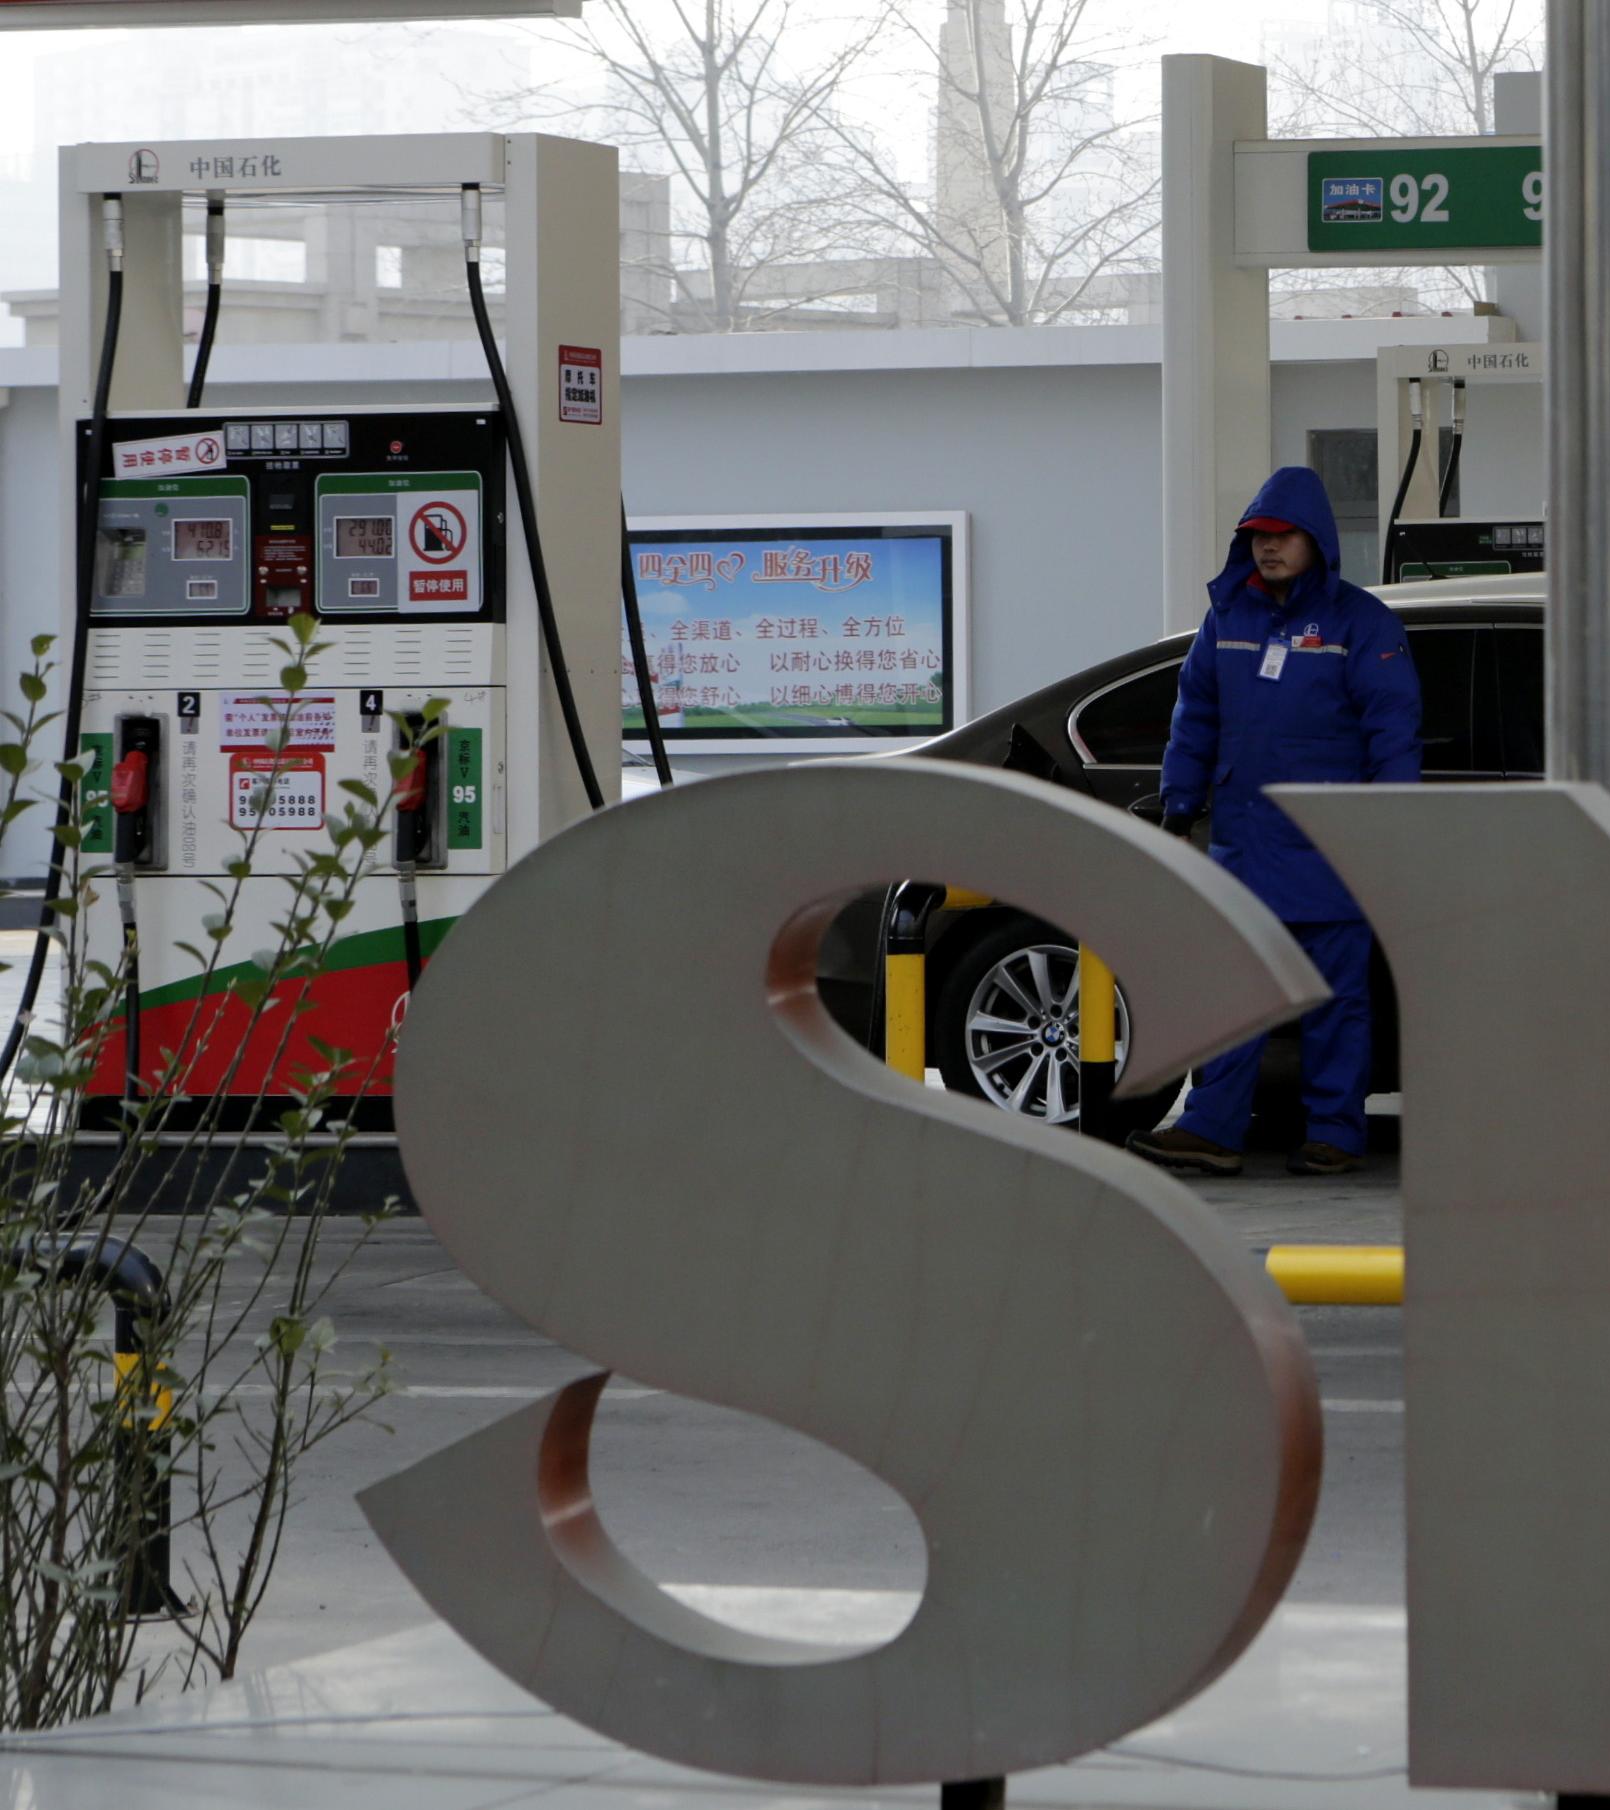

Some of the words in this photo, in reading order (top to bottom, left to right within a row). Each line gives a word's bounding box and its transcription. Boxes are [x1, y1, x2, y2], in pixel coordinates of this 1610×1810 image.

[190, 154, 282, 180] 中国石化
[1329, 183, 1376, 196] 加油卡
[1389, 173, 1449, 223] 92
[1467, 352, 1530, 370] 中国石化
[752, 546, 874, 592] 服务升级
[413, 578, 464, 593] 暂停使用
[630, 615, 906, 644] 、全渠道、全过程、全方位
[769, 648, 942, 674] 以耐心换得您省心
[365, 694, 377, 711] 4
[769, 682, 943, 707] 以细心博得您开心
[182, 696, 195, 714] 2
[452, 785, 476, 804] 95
[239, 807, 316, 817] 9505988
